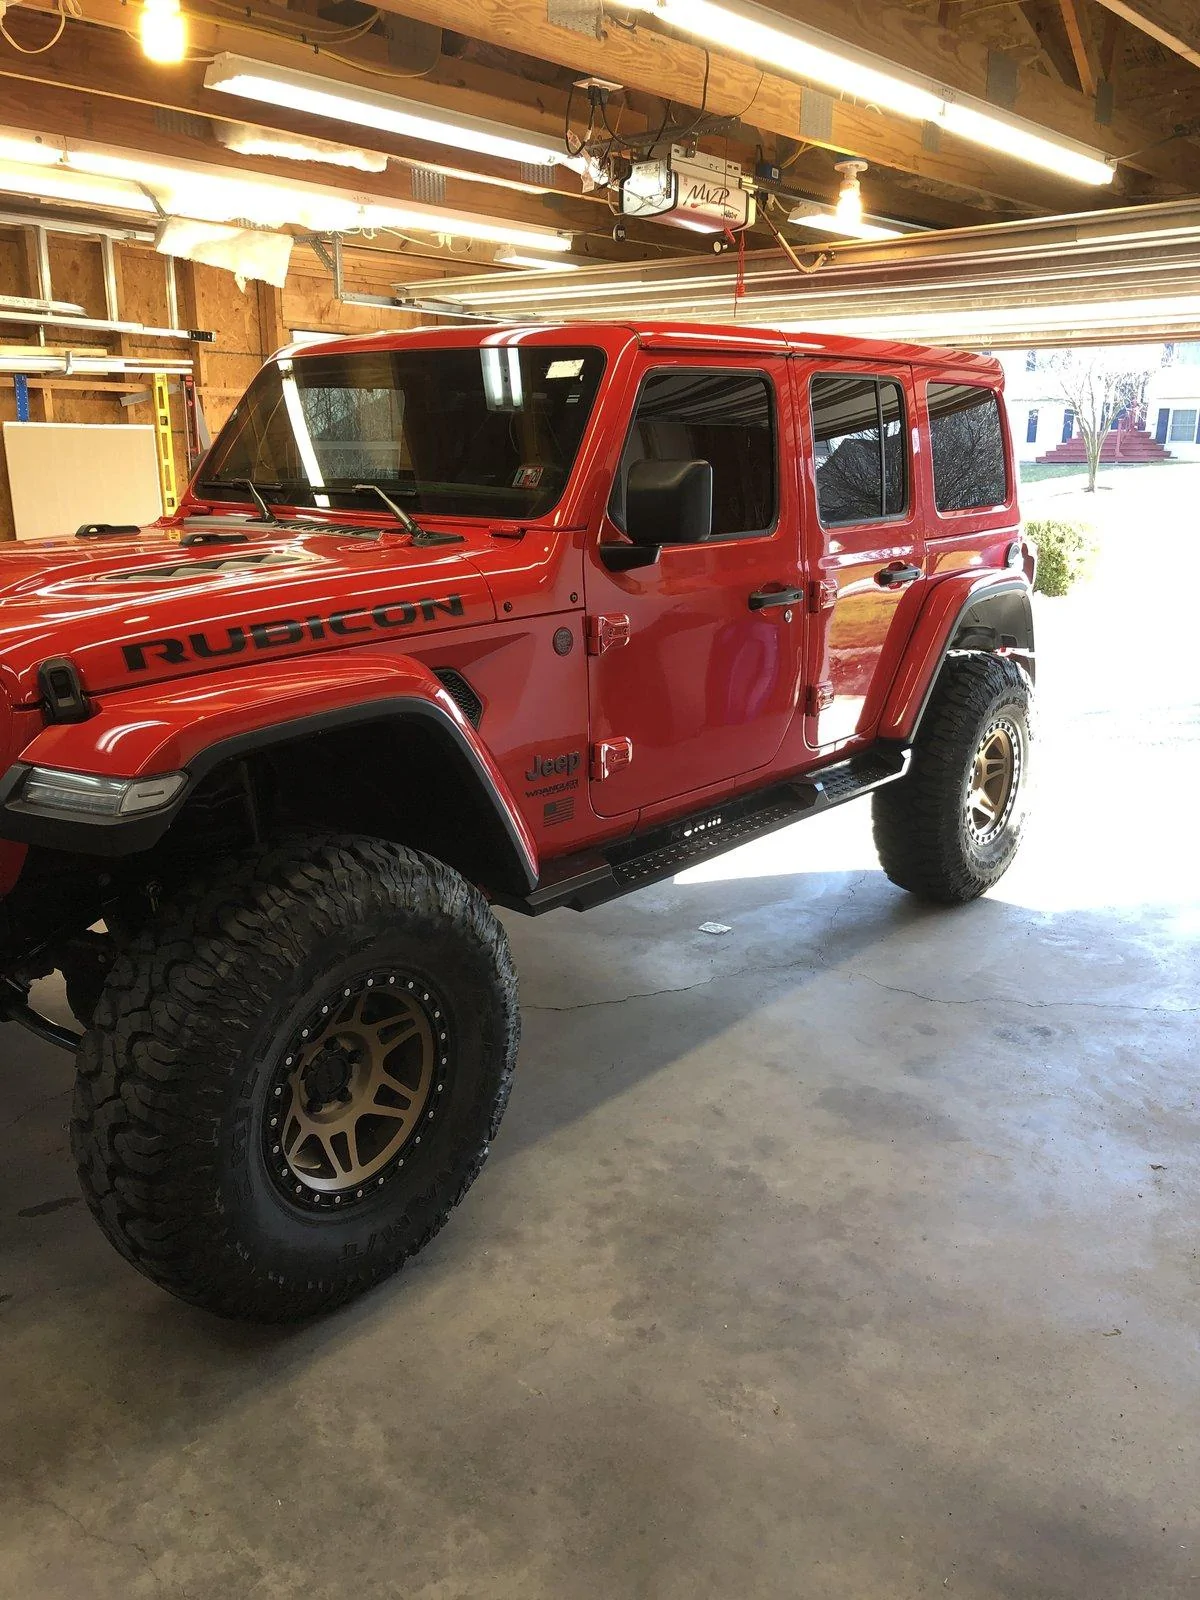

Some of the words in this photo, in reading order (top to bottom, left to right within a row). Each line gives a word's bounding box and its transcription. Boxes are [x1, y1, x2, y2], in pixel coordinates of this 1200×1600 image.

[683, 183, 730, 206] MVP
[121, 593, 465, 673] RUBICON
[525, 751, 580, 781] Jeep
[524, 778, 579, 797] WRANGLER
